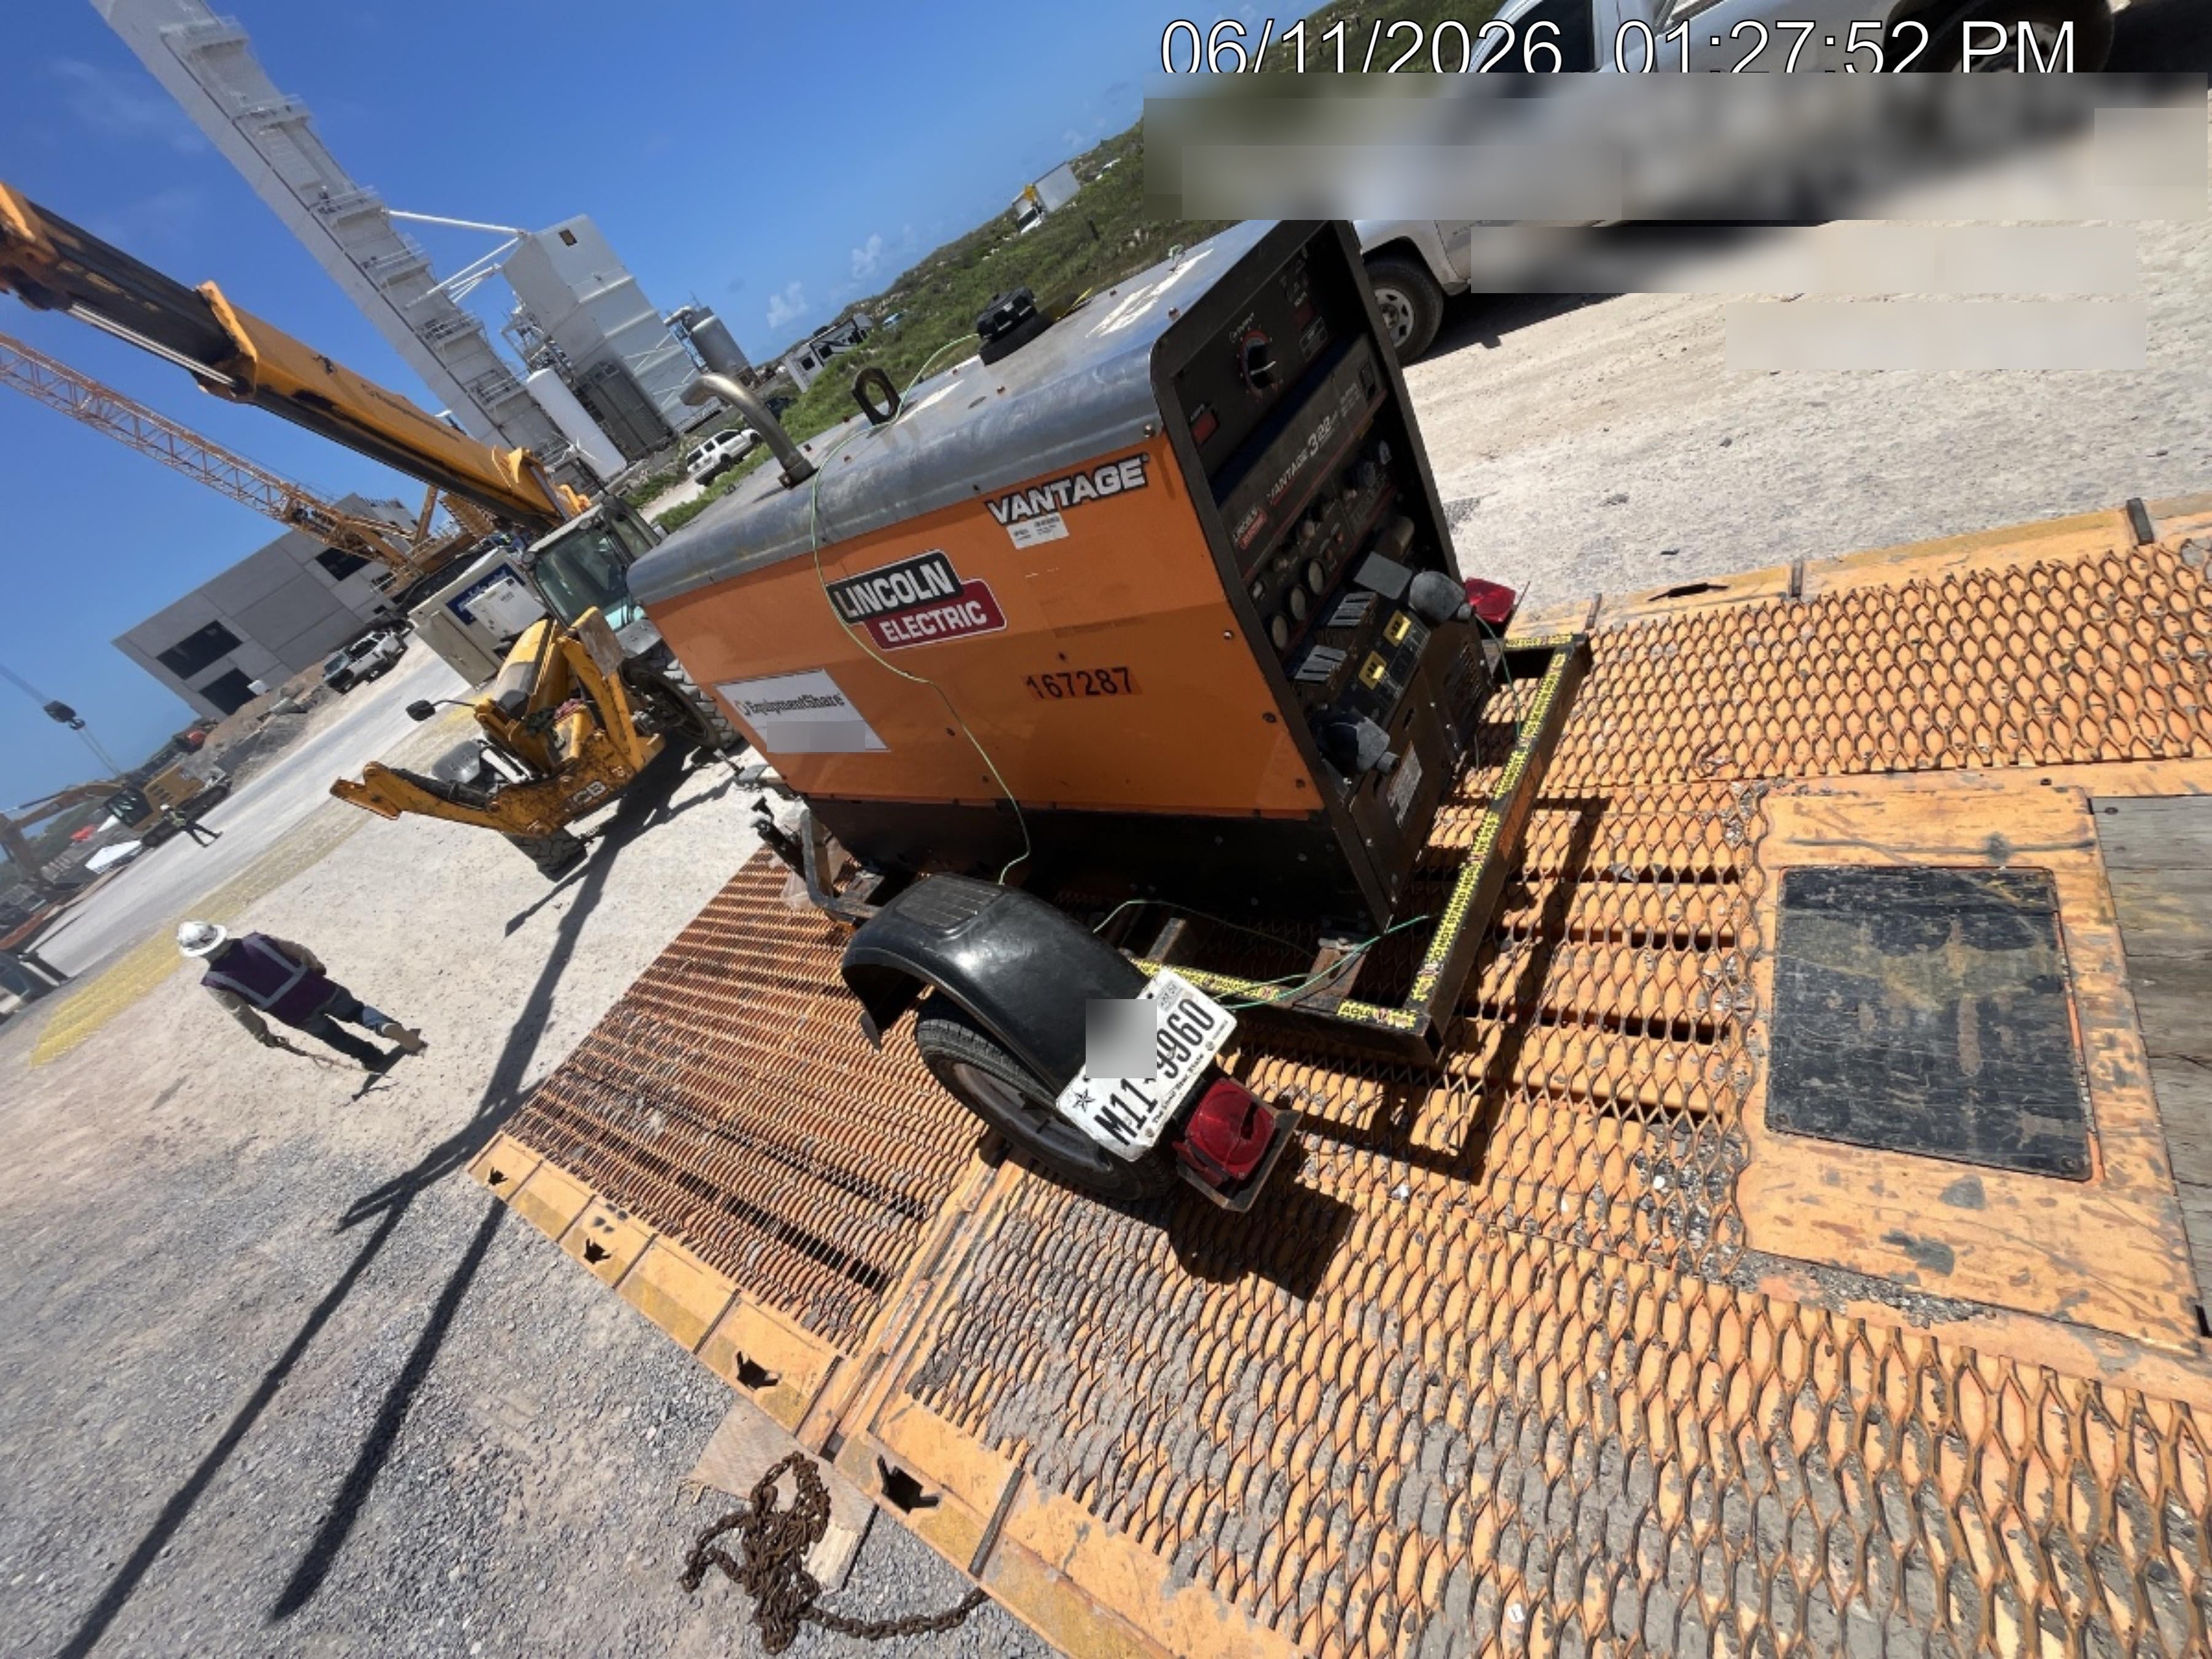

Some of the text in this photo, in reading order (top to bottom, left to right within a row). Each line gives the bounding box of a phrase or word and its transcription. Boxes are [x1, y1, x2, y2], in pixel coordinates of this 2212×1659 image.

[986, 456, 1148, 525] VANTAGE
[834, 560, 955, 618] LINCOLN
[879, 600, 987, 642] ELECTRIC
[1027, 667, 1132, 699] 167287
